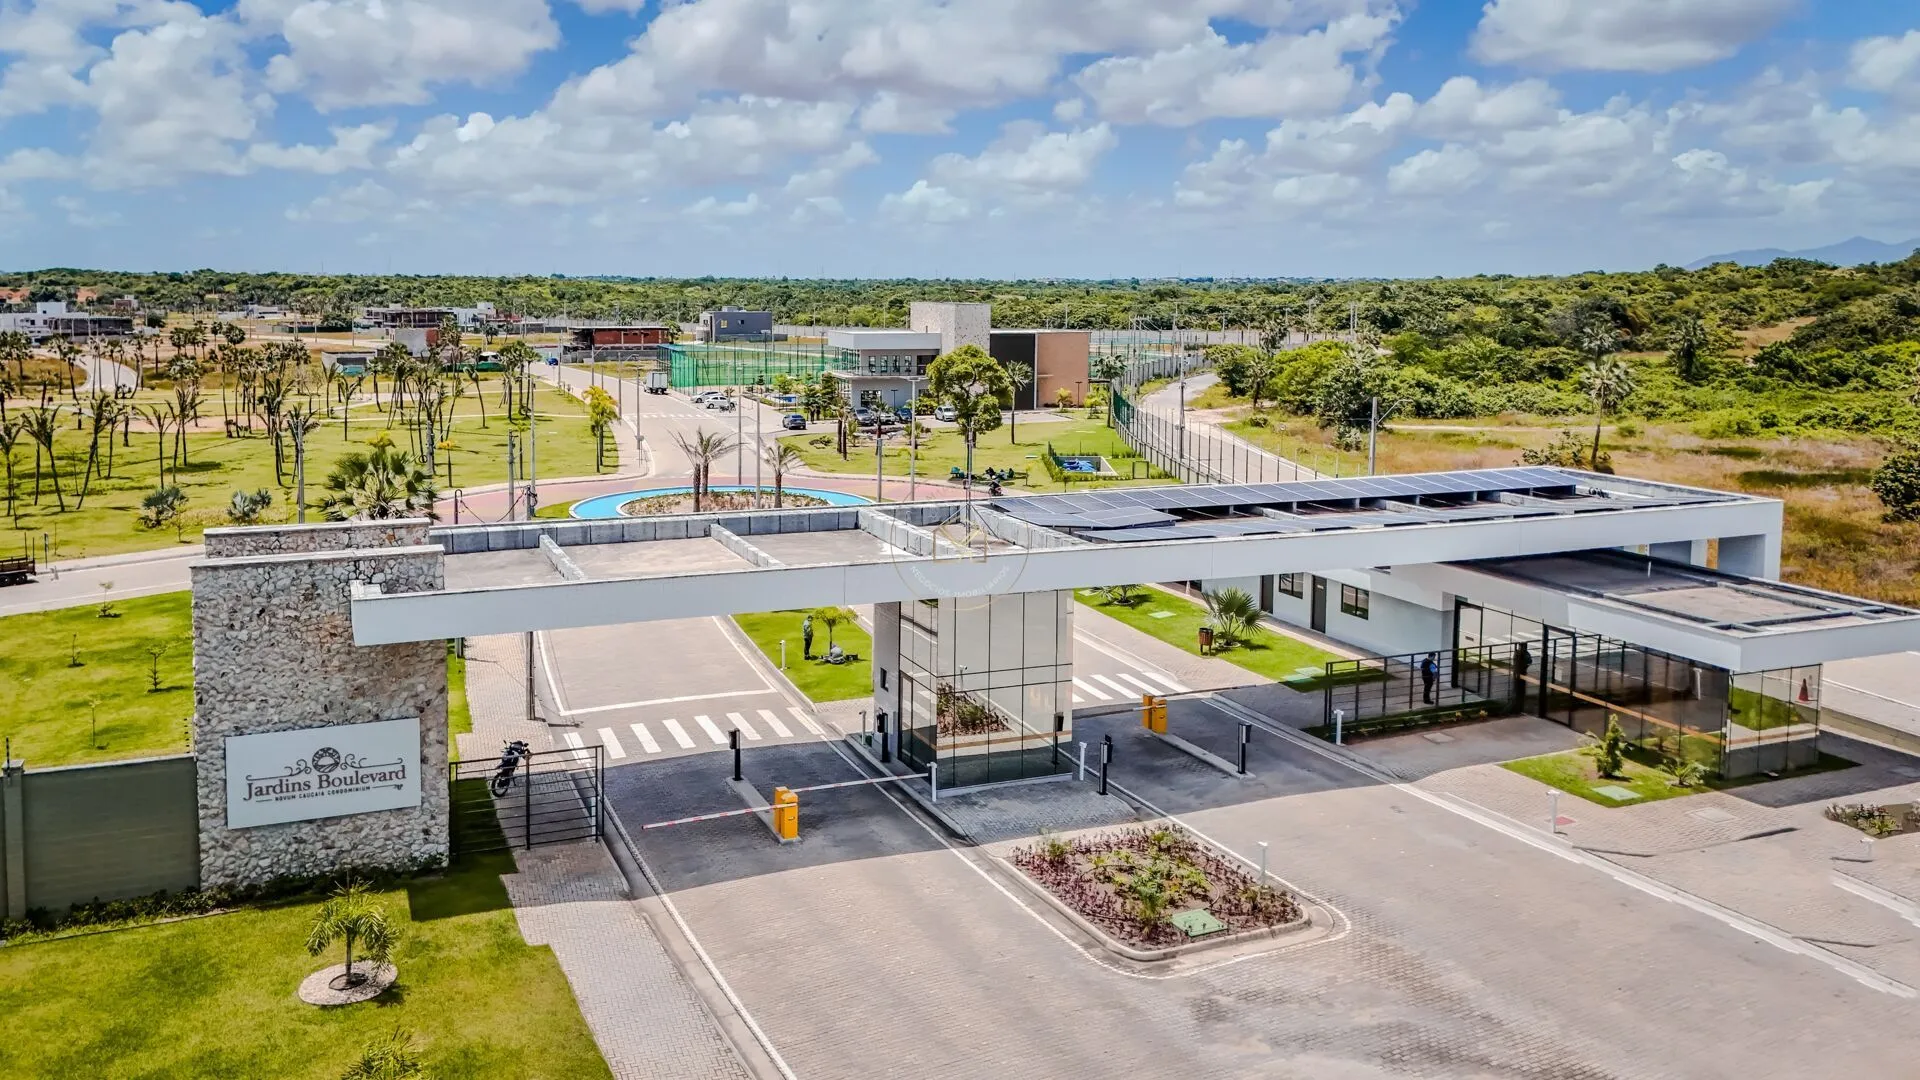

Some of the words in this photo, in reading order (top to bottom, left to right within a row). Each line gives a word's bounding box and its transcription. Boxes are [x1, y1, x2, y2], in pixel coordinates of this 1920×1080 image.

[243, 779, 311, 801] Jardins
[317, 765, 407, 789] Boulevard
[299, 791, 325, 799] CAUCAIA
[328, 786, 371, 795] CONDOMINIUM
